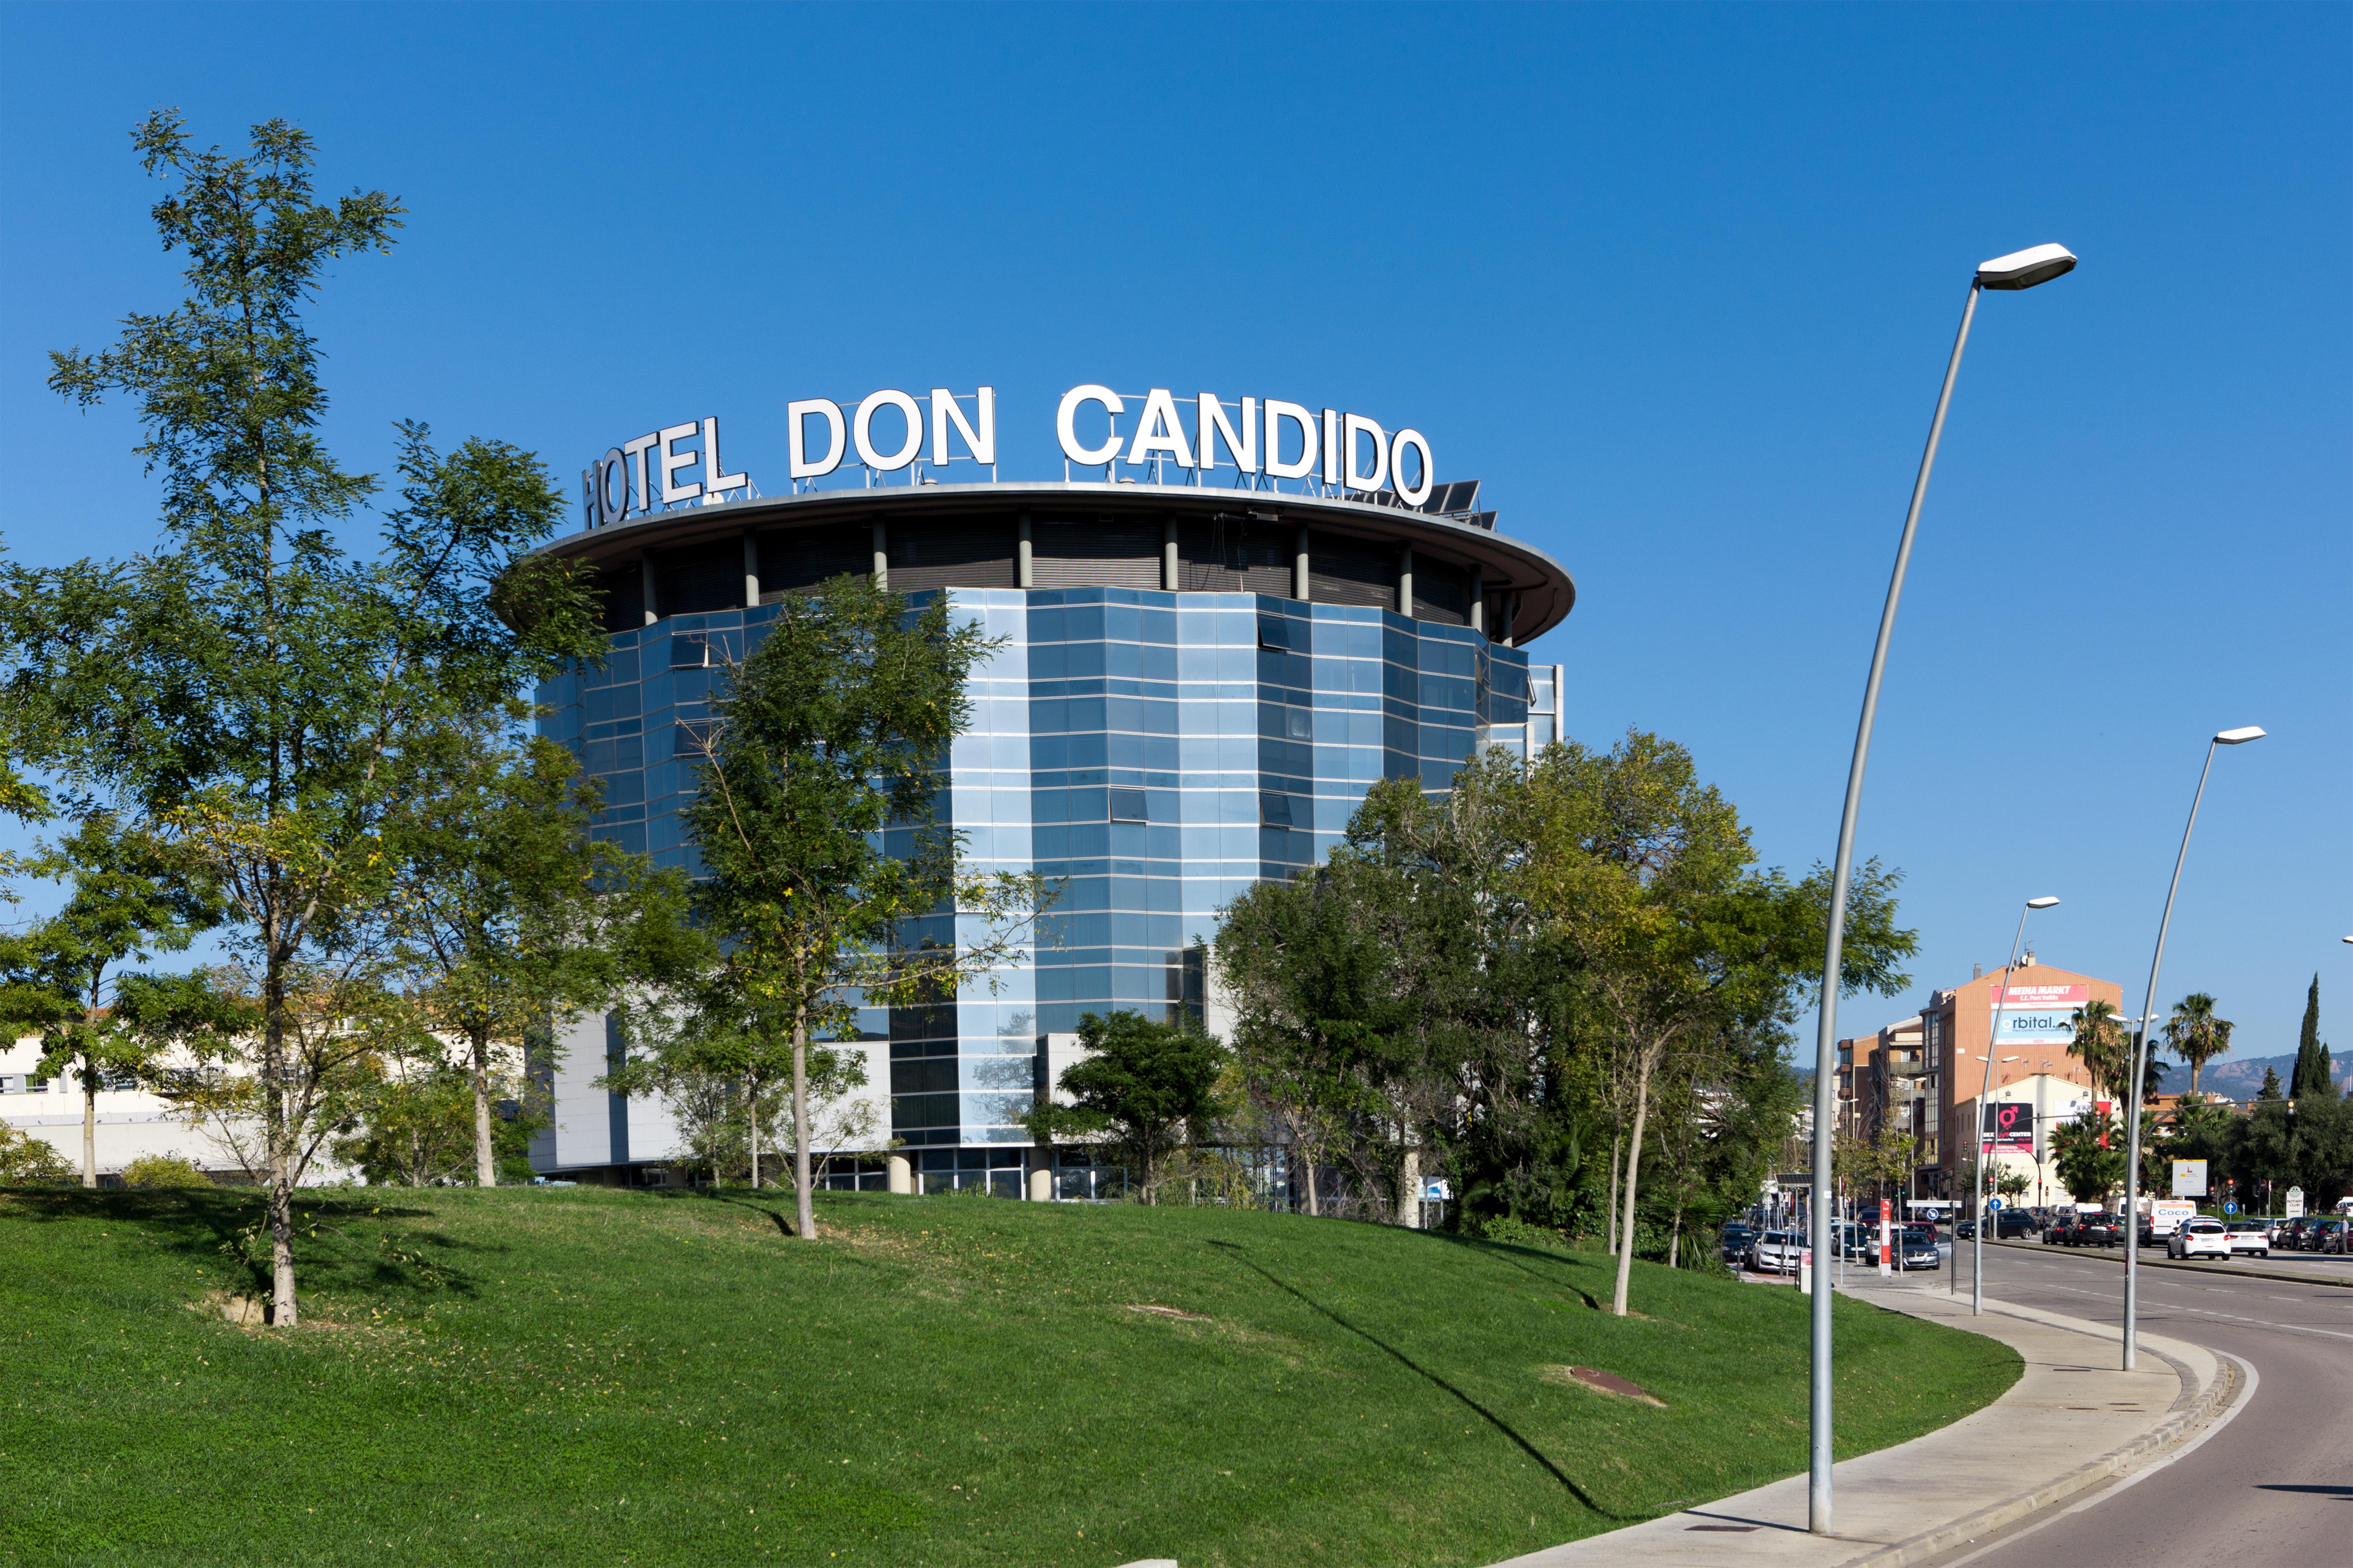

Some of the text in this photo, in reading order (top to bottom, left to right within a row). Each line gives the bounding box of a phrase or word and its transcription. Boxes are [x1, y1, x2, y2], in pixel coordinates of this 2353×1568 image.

[582, 384, 1434, 530] HOTEL DON CANDIDO
[2008, 985, 2071, 995] MEDIA MARKT
